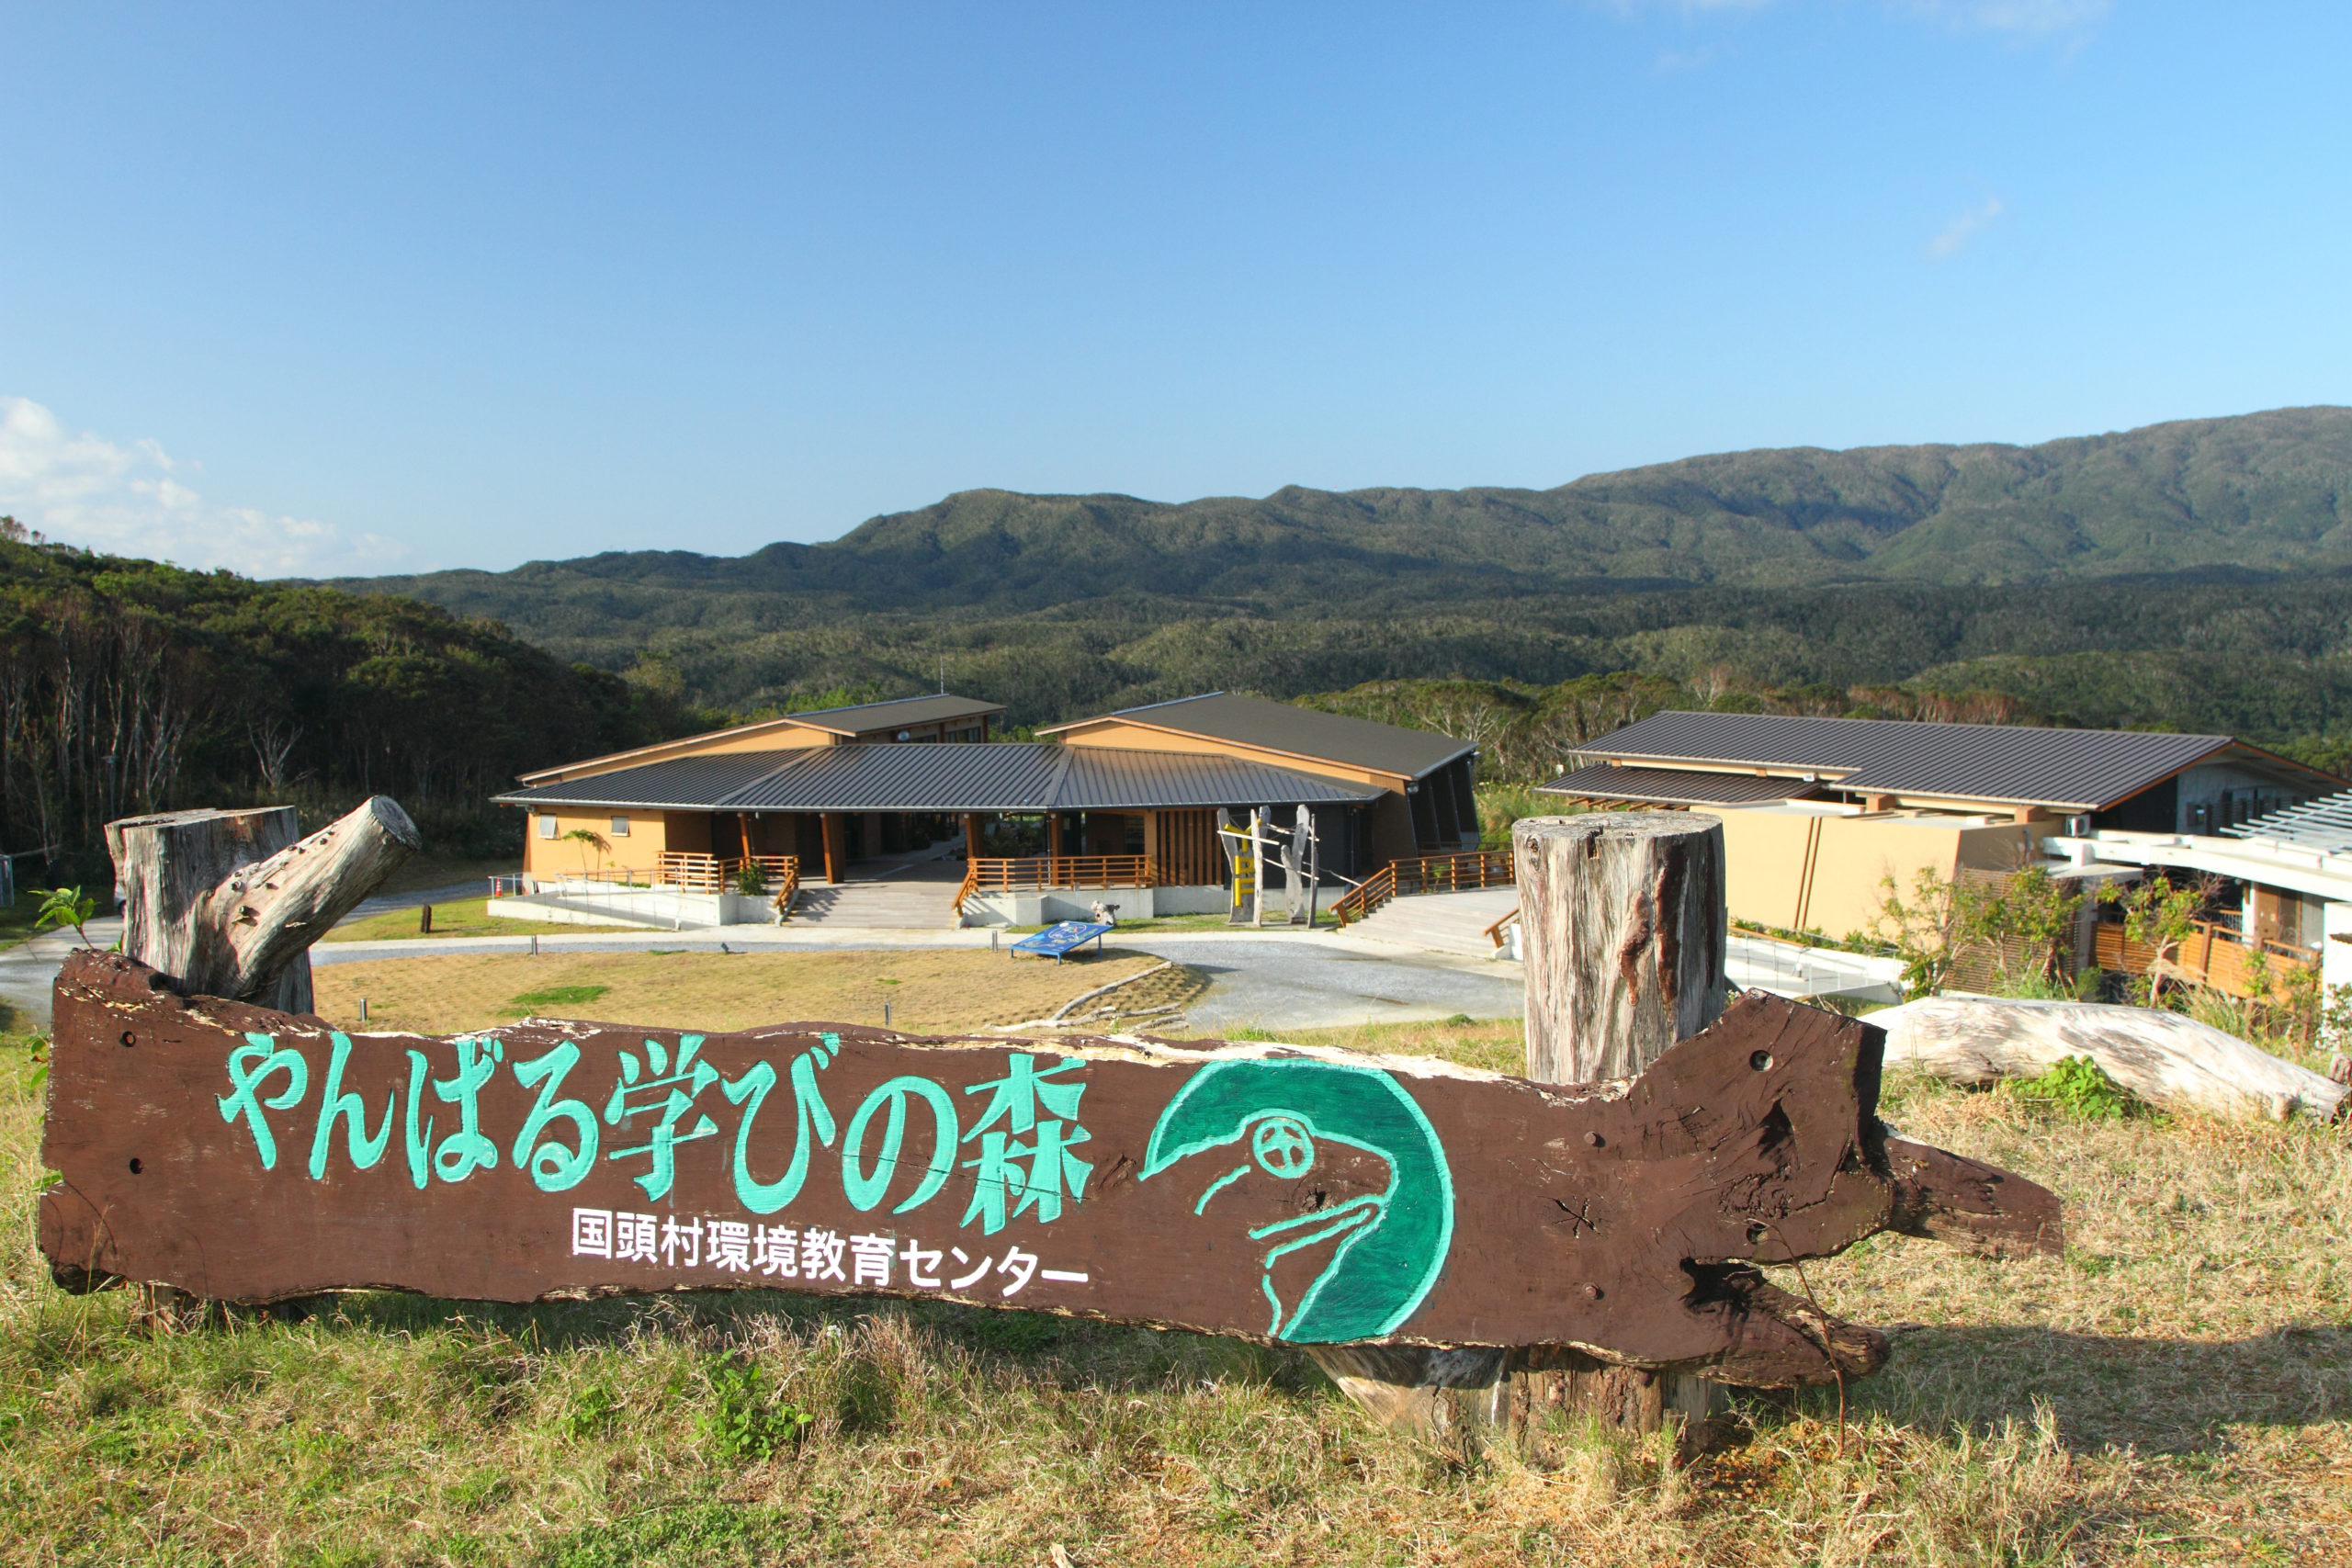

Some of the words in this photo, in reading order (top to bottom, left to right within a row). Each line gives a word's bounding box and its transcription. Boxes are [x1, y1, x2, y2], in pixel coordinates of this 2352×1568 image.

[218, 1032, 1094, 1235] やんばる学びの森
[571, 1207, 1089, 1297] 国頭村環境教育センター
